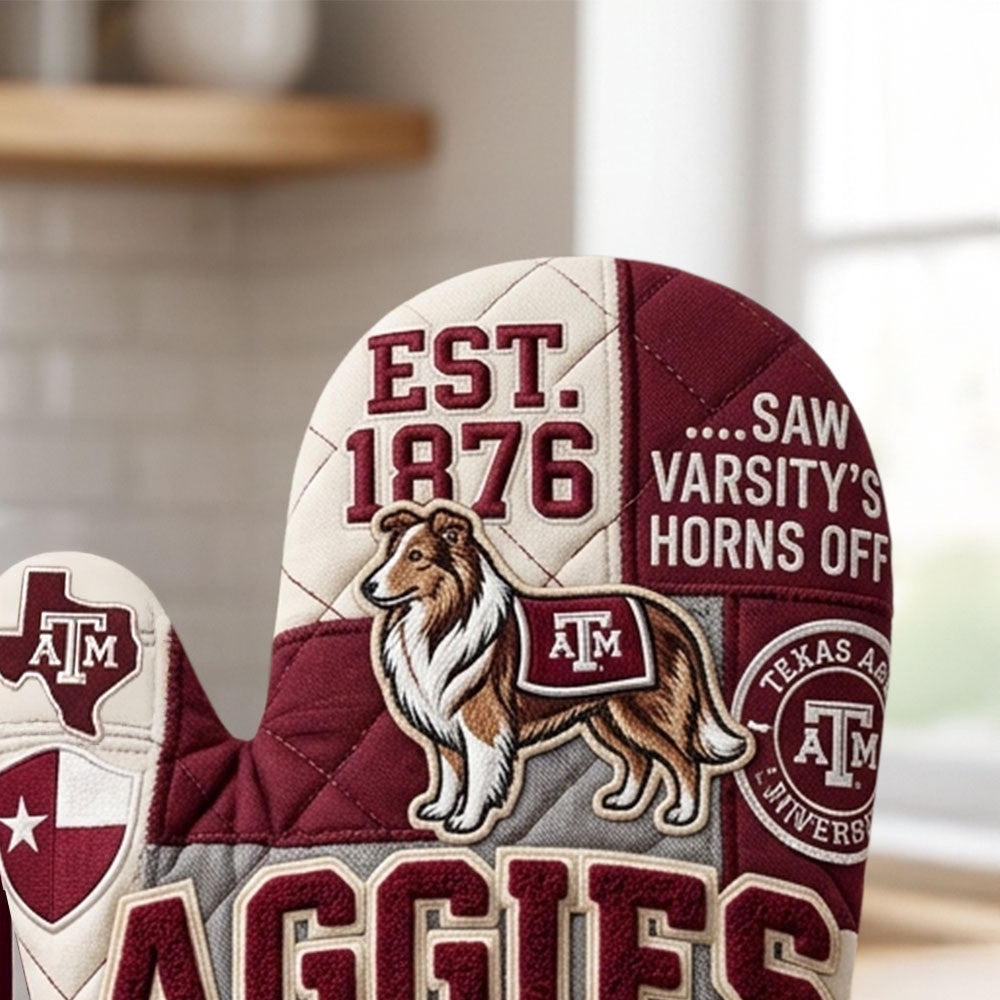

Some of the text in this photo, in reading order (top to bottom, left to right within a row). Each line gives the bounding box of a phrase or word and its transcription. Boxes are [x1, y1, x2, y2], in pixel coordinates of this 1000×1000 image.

[367, 323, 580, 415] EST.
[345, 420, 594, 524] 1876
[650, 450, 883, 519] VARSITY'S
[650, 514, 890, 583] HORNS OFF
[759, 638, 851, 694] TEXAS
